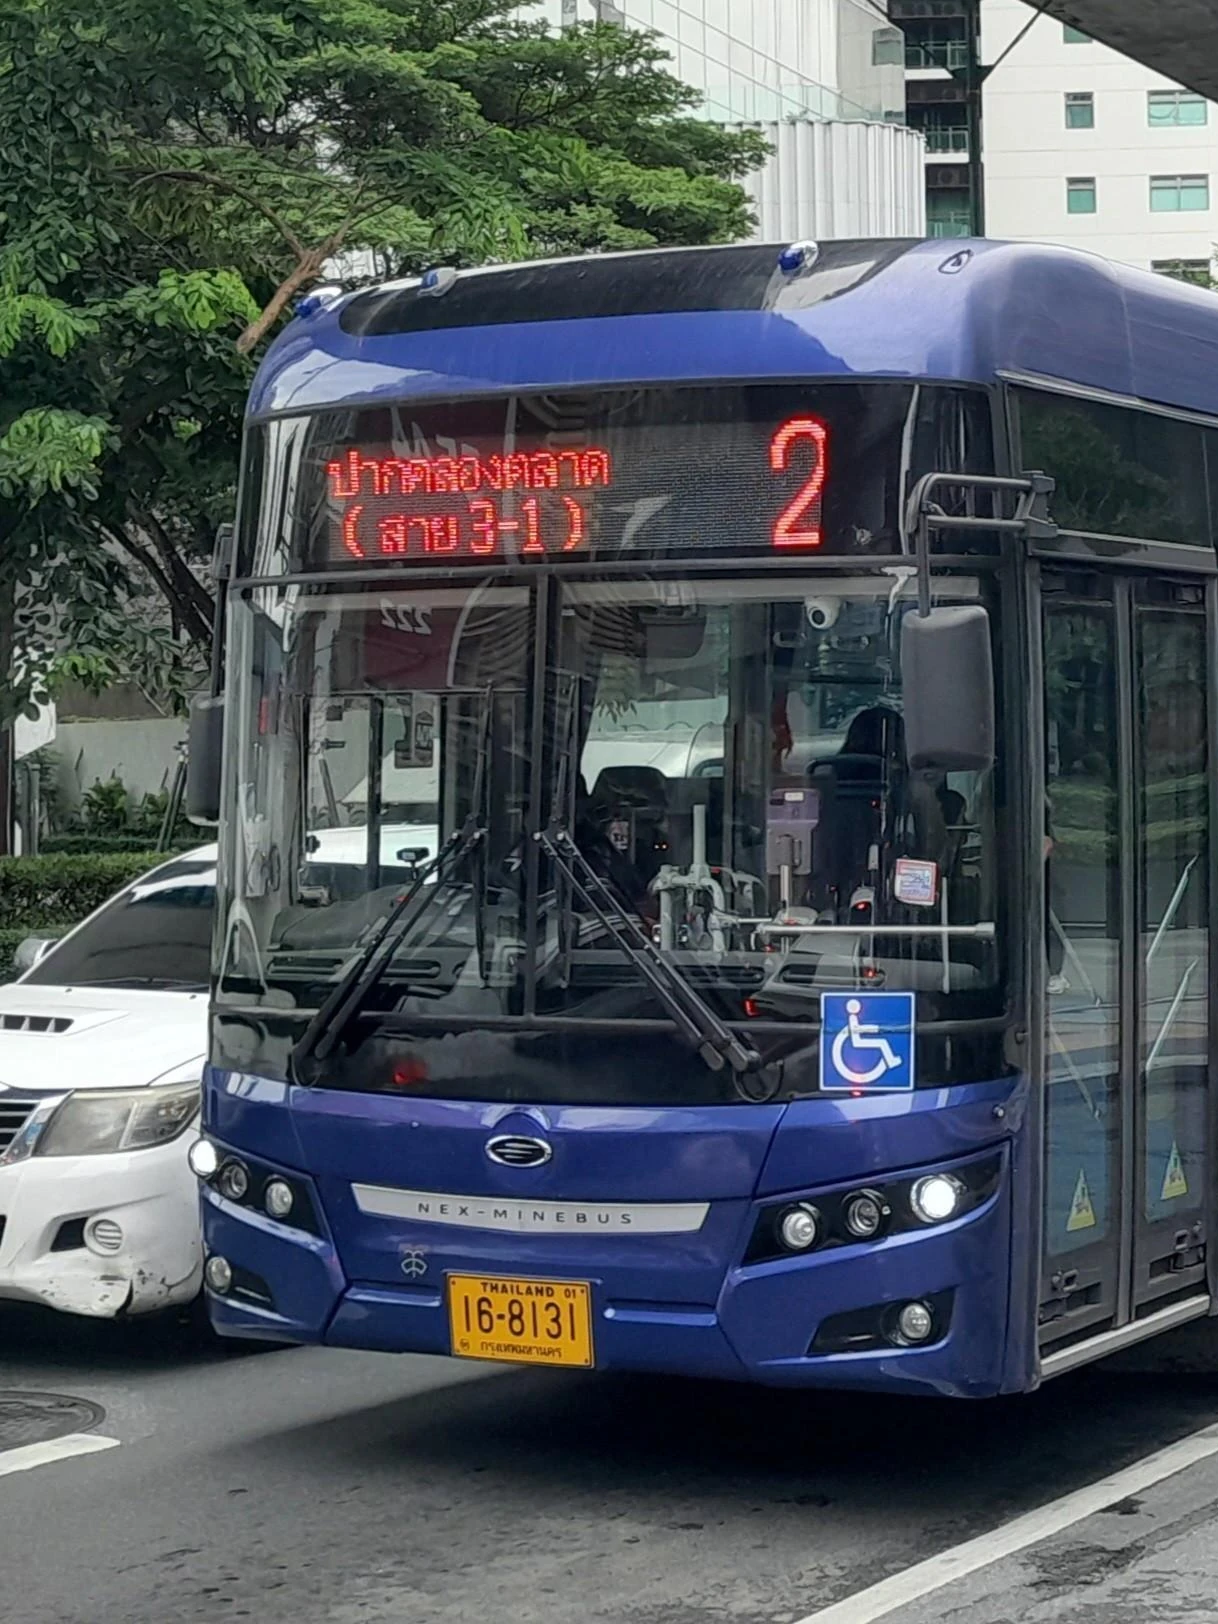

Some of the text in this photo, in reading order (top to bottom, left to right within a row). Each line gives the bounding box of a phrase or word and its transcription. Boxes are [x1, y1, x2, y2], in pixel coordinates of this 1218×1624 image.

[328, 450, 611, 496] ปากคลองตลาด
[770, 419, 826, 546] 2
[417, 1202, 633, 1225] NEX-MINEBUS
[480, 1282, 577, 1299] THAILAND 01
[463, 1295, 576, 1341] 16-8131
